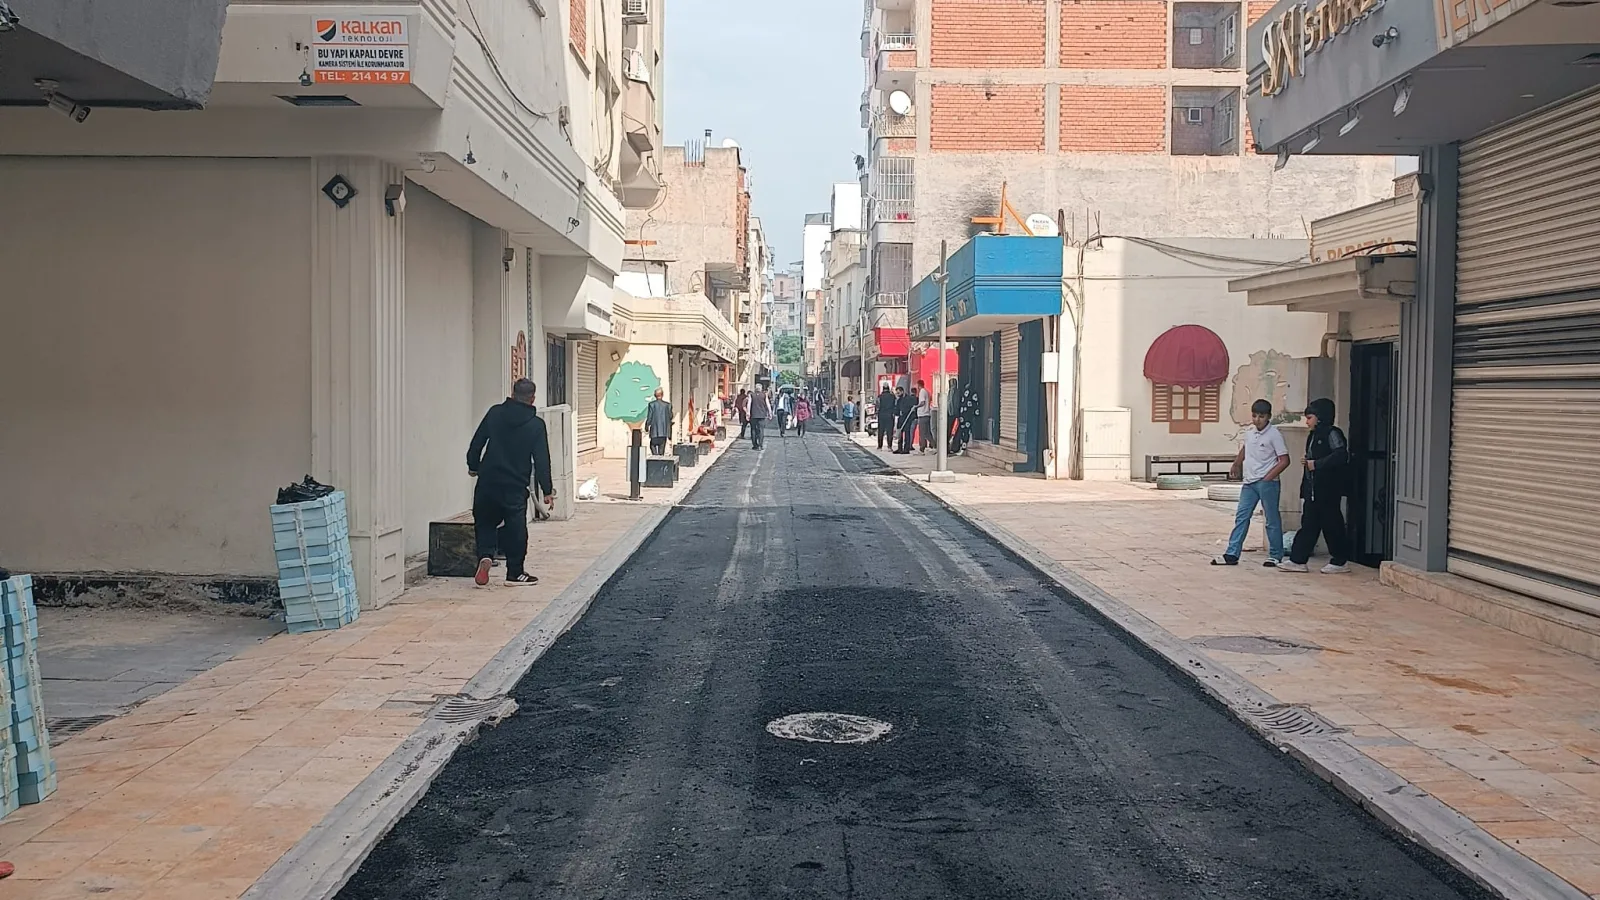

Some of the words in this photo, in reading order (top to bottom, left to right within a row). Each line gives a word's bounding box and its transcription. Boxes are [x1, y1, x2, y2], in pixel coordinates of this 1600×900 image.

[317, 49, 329, 58] BU
[330, 49, 348, 58] YAPI
[349, 49, 377, 58] KAPALI
[378, 49, 404, 59] DEVRE
[318, 60, 338, 68] KAMERA
[319, 71, 346, 81] TEL:
[352, 71, 371, 81] 214
[375, 72, 387, 81] 14
[391, 72, 405, 81] 97
